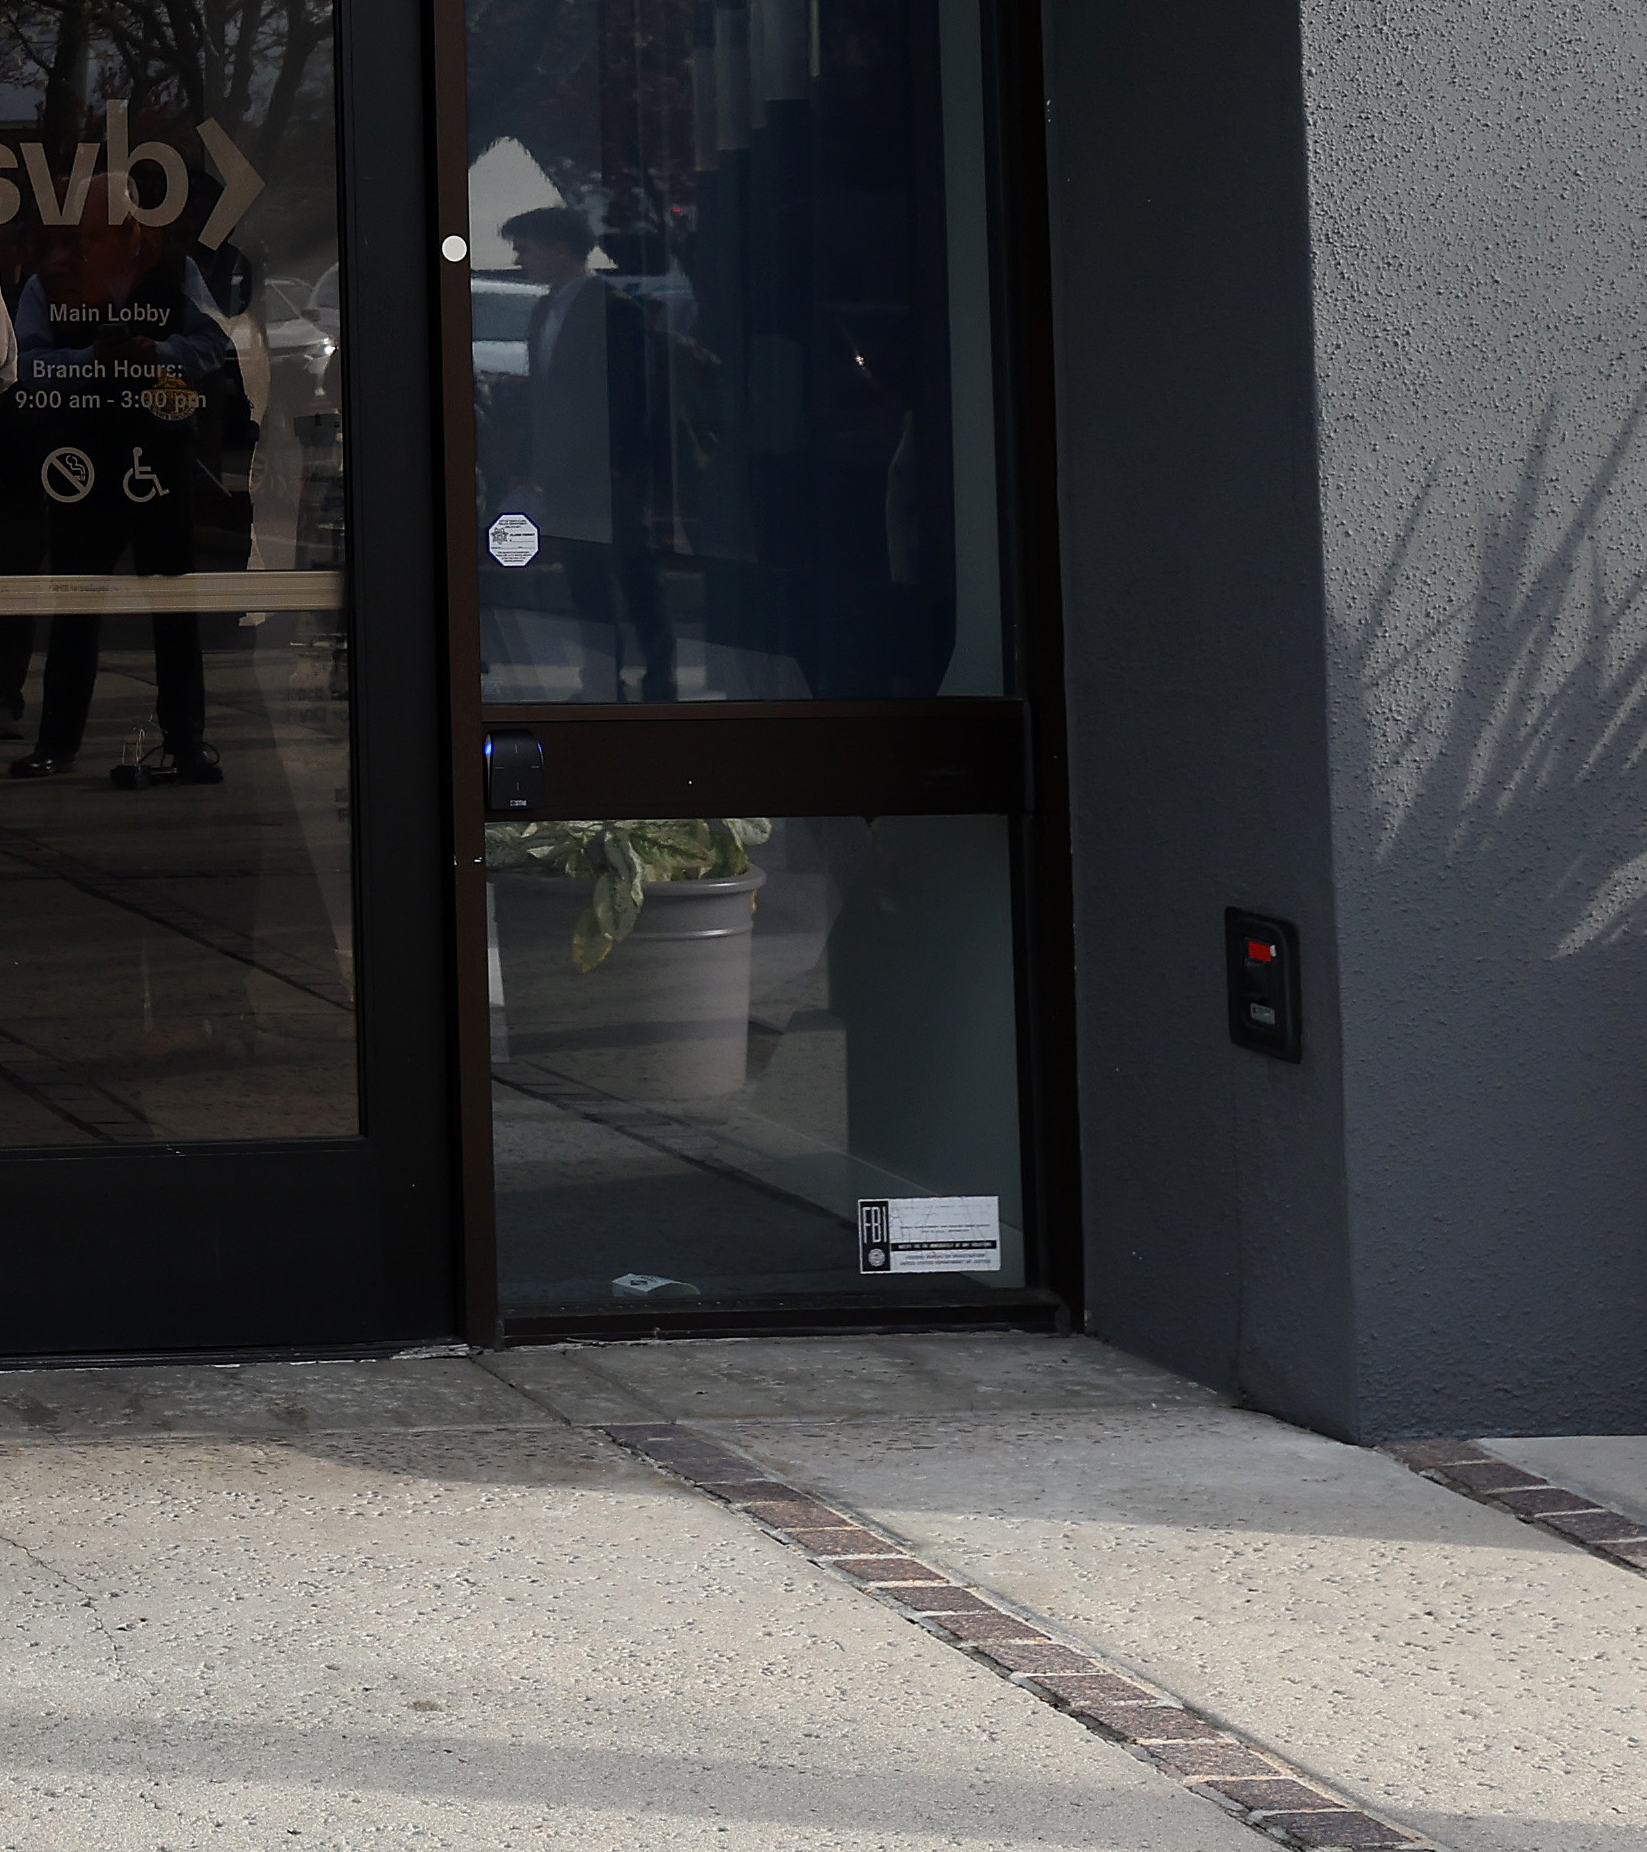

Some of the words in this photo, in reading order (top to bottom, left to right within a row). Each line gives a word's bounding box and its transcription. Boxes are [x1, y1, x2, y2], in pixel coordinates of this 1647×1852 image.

[49, 303, 100, 323] Main
[107, 303, 171, 326] Lobby
[32, 359, 106, 379] Branch
[113, 359, 183, 379] Hours:
[15, 390, 62, 409] 9:00
[68, 394, 101, 409] am
[120, 390, 168, 409] 3:00
[175, 394, 207, 413] pm
[862, 1205, 888, 1244] FBI
